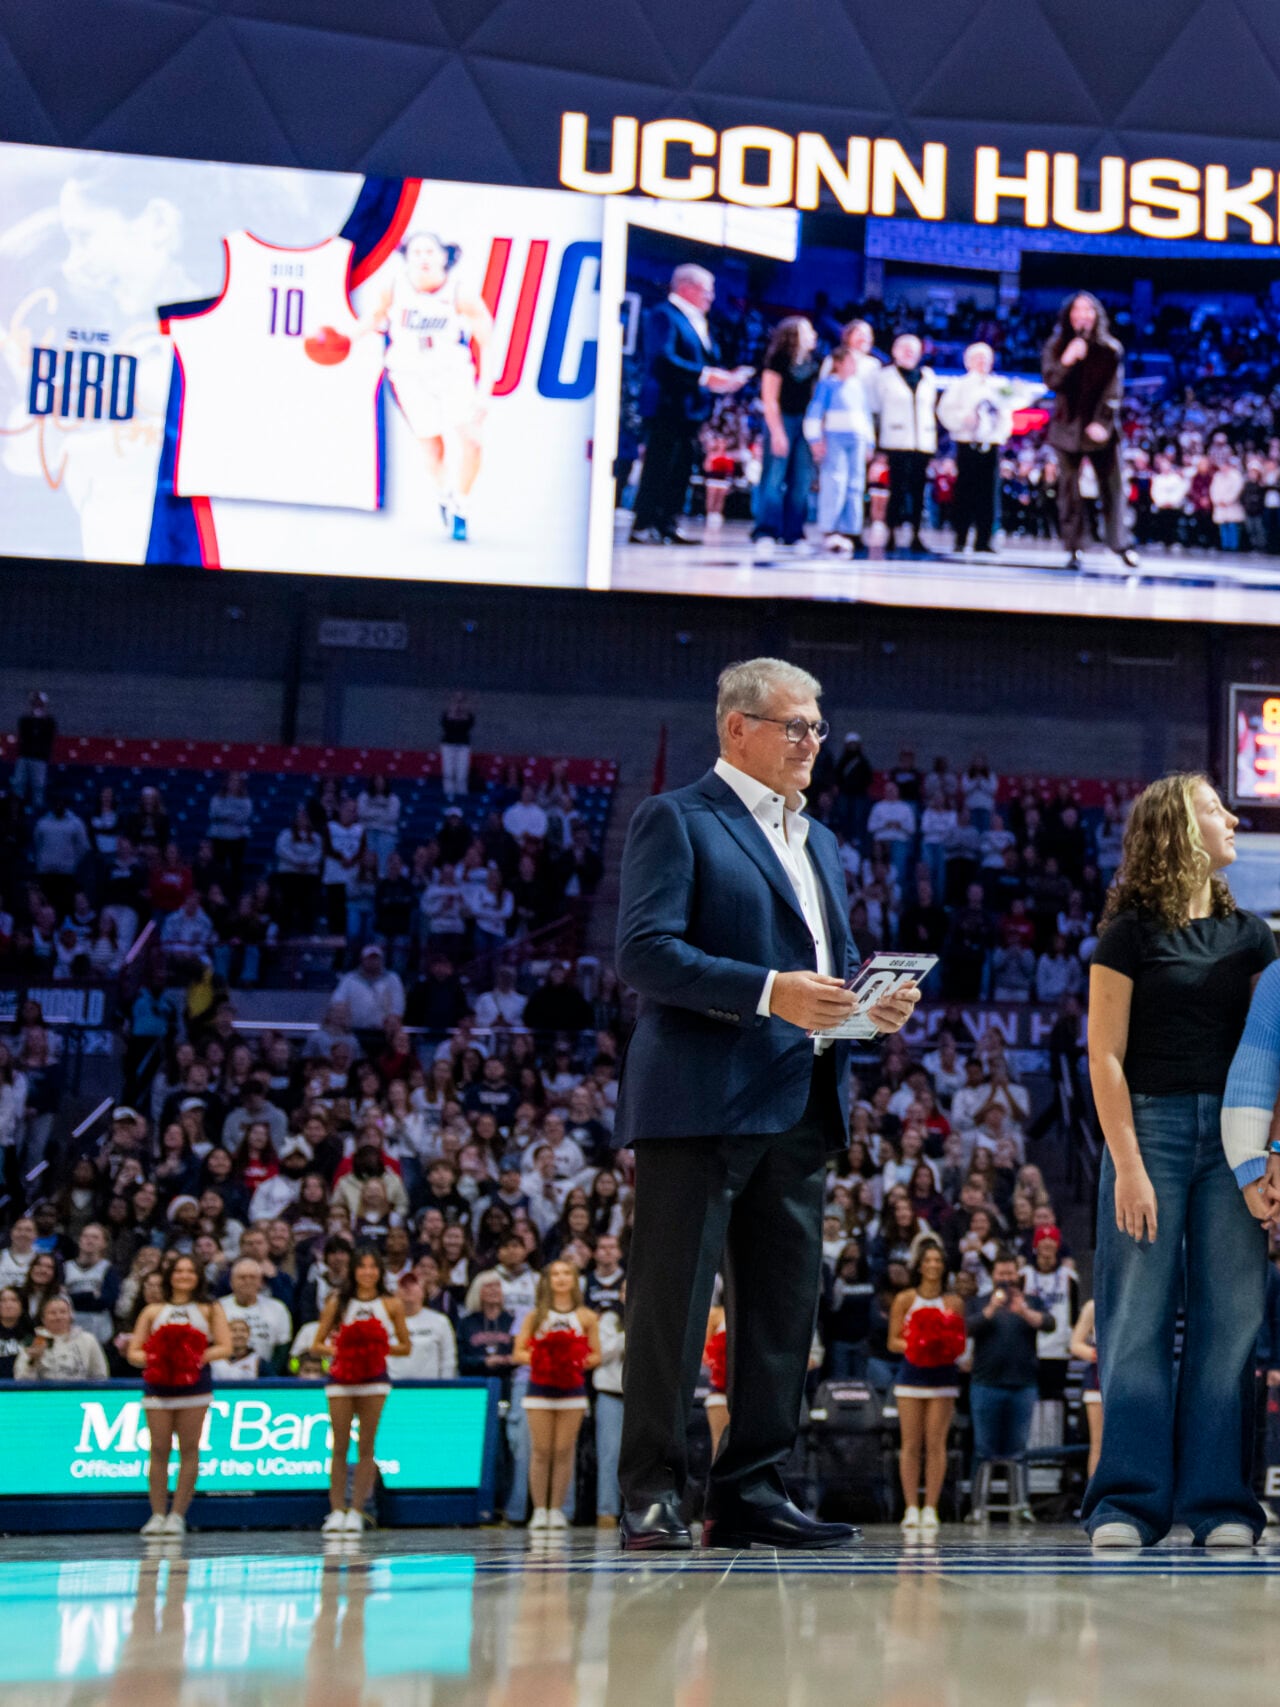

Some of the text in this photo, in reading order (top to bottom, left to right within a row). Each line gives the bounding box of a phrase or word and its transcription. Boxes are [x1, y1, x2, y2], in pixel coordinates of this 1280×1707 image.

[559, 111, 947, 220] UCONN
[269, 286, 305, 337] 10
[28, 346, 137, 421] BIRD
[230, 1400, 361, 1451] Ban
[70, 1459, 142, 1478] Official
[220, 1458, 254, 1476] the
[256, 1457, 323, 1476] UConn
